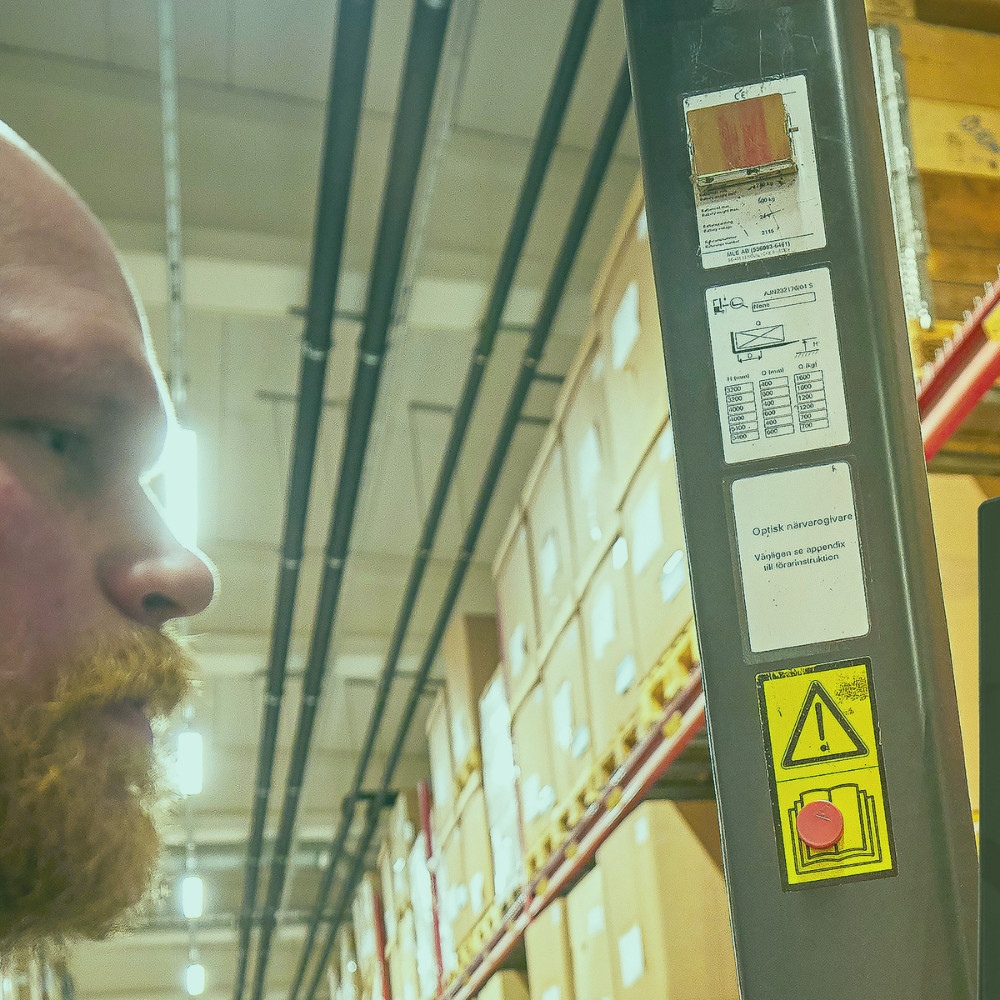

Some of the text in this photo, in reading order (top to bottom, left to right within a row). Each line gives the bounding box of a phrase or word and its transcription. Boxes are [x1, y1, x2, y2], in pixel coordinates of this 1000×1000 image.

[752, 523, 784, 537] Optisk
[806, 540, 845, 555] appendix
[763, 563, 772, 571] till
